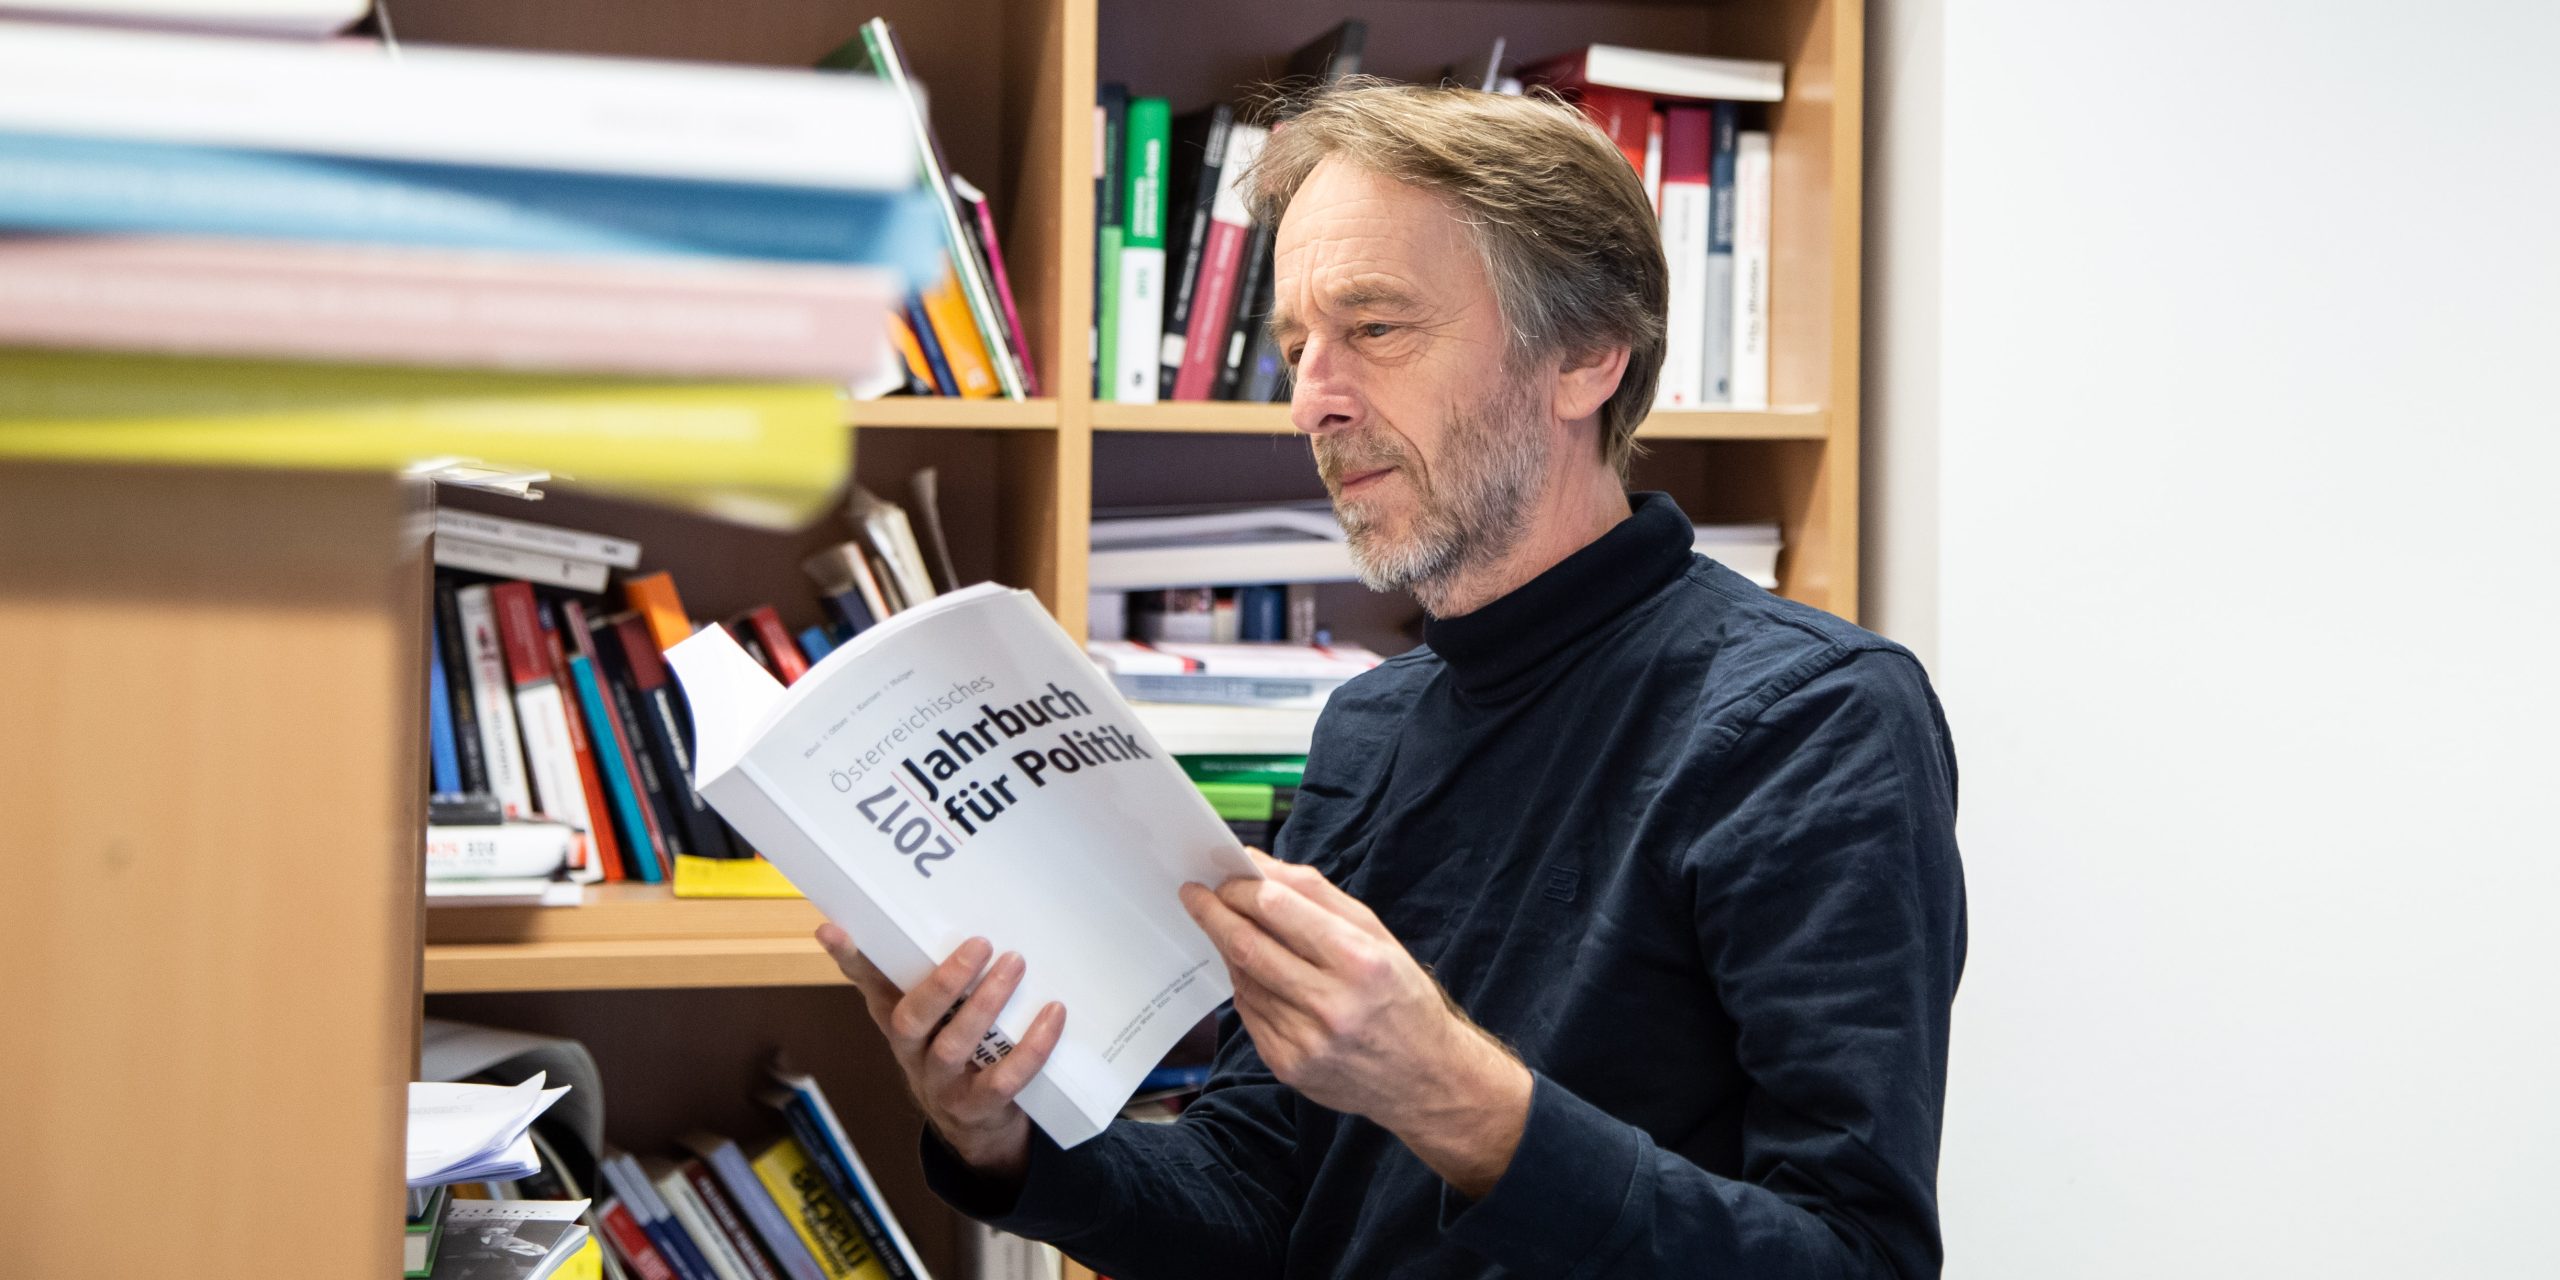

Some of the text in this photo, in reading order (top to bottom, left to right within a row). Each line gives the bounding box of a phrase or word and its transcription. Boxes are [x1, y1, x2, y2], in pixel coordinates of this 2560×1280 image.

[830, 674, 995, 793] Österreichisches
[901, 682, 1093, 802] Jahrbuch
[943, 725, 1153, 836] für Politik
[855, 785, 956, 879] 2017
